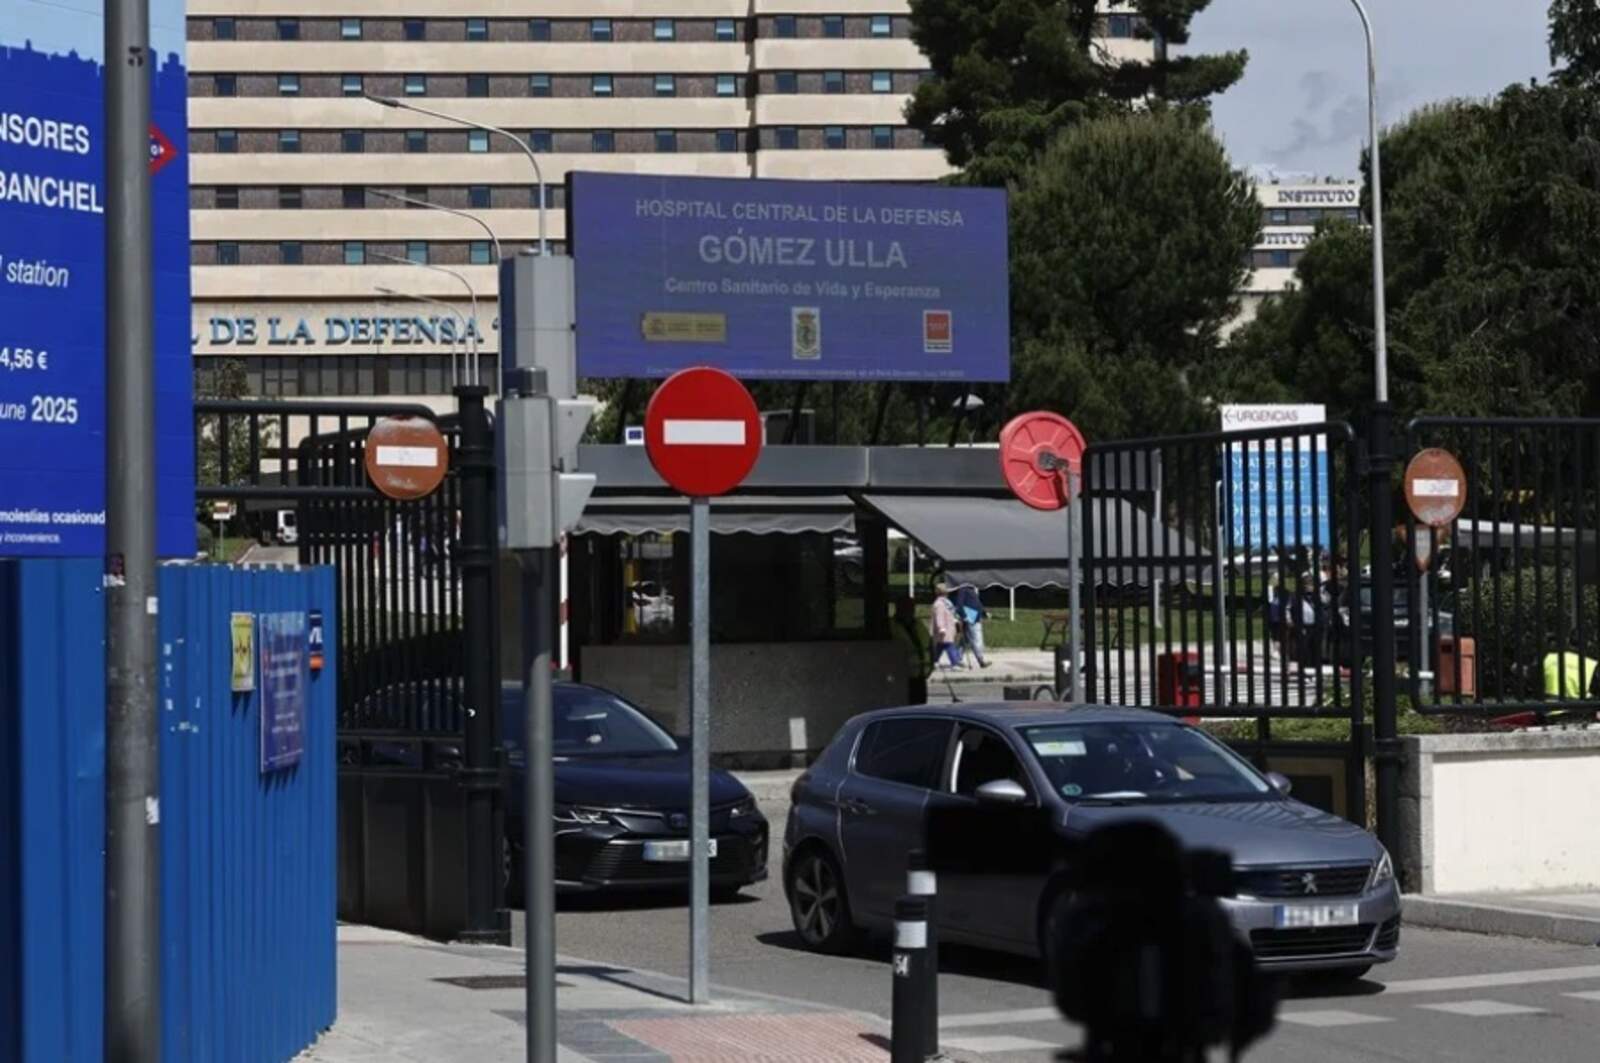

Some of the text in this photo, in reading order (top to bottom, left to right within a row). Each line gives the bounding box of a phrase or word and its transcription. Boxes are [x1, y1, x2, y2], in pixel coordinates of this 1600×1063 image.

[1278, 189, 1356, 203] INSTITUTO
[635, 199, 964, 226] HOSPITAL CENTRAL DE LA DEFENSA
[699, 227, 908, 268] GÓMEZ ULLA
[6, 258, 69, 288] station
[665, 277, 942, 300] Centro Sanitario de Vida y Esperanza
[209, 317, 259, 345] DE
[268, 317, 316, 345] LA
[325, 318, 484, 345] DEFENSA
[0, 347, 48, 371] 4,56 €
[31, 395, 78, 424] 2025
[1236, 410, 1299, 421] URGENCIAS
